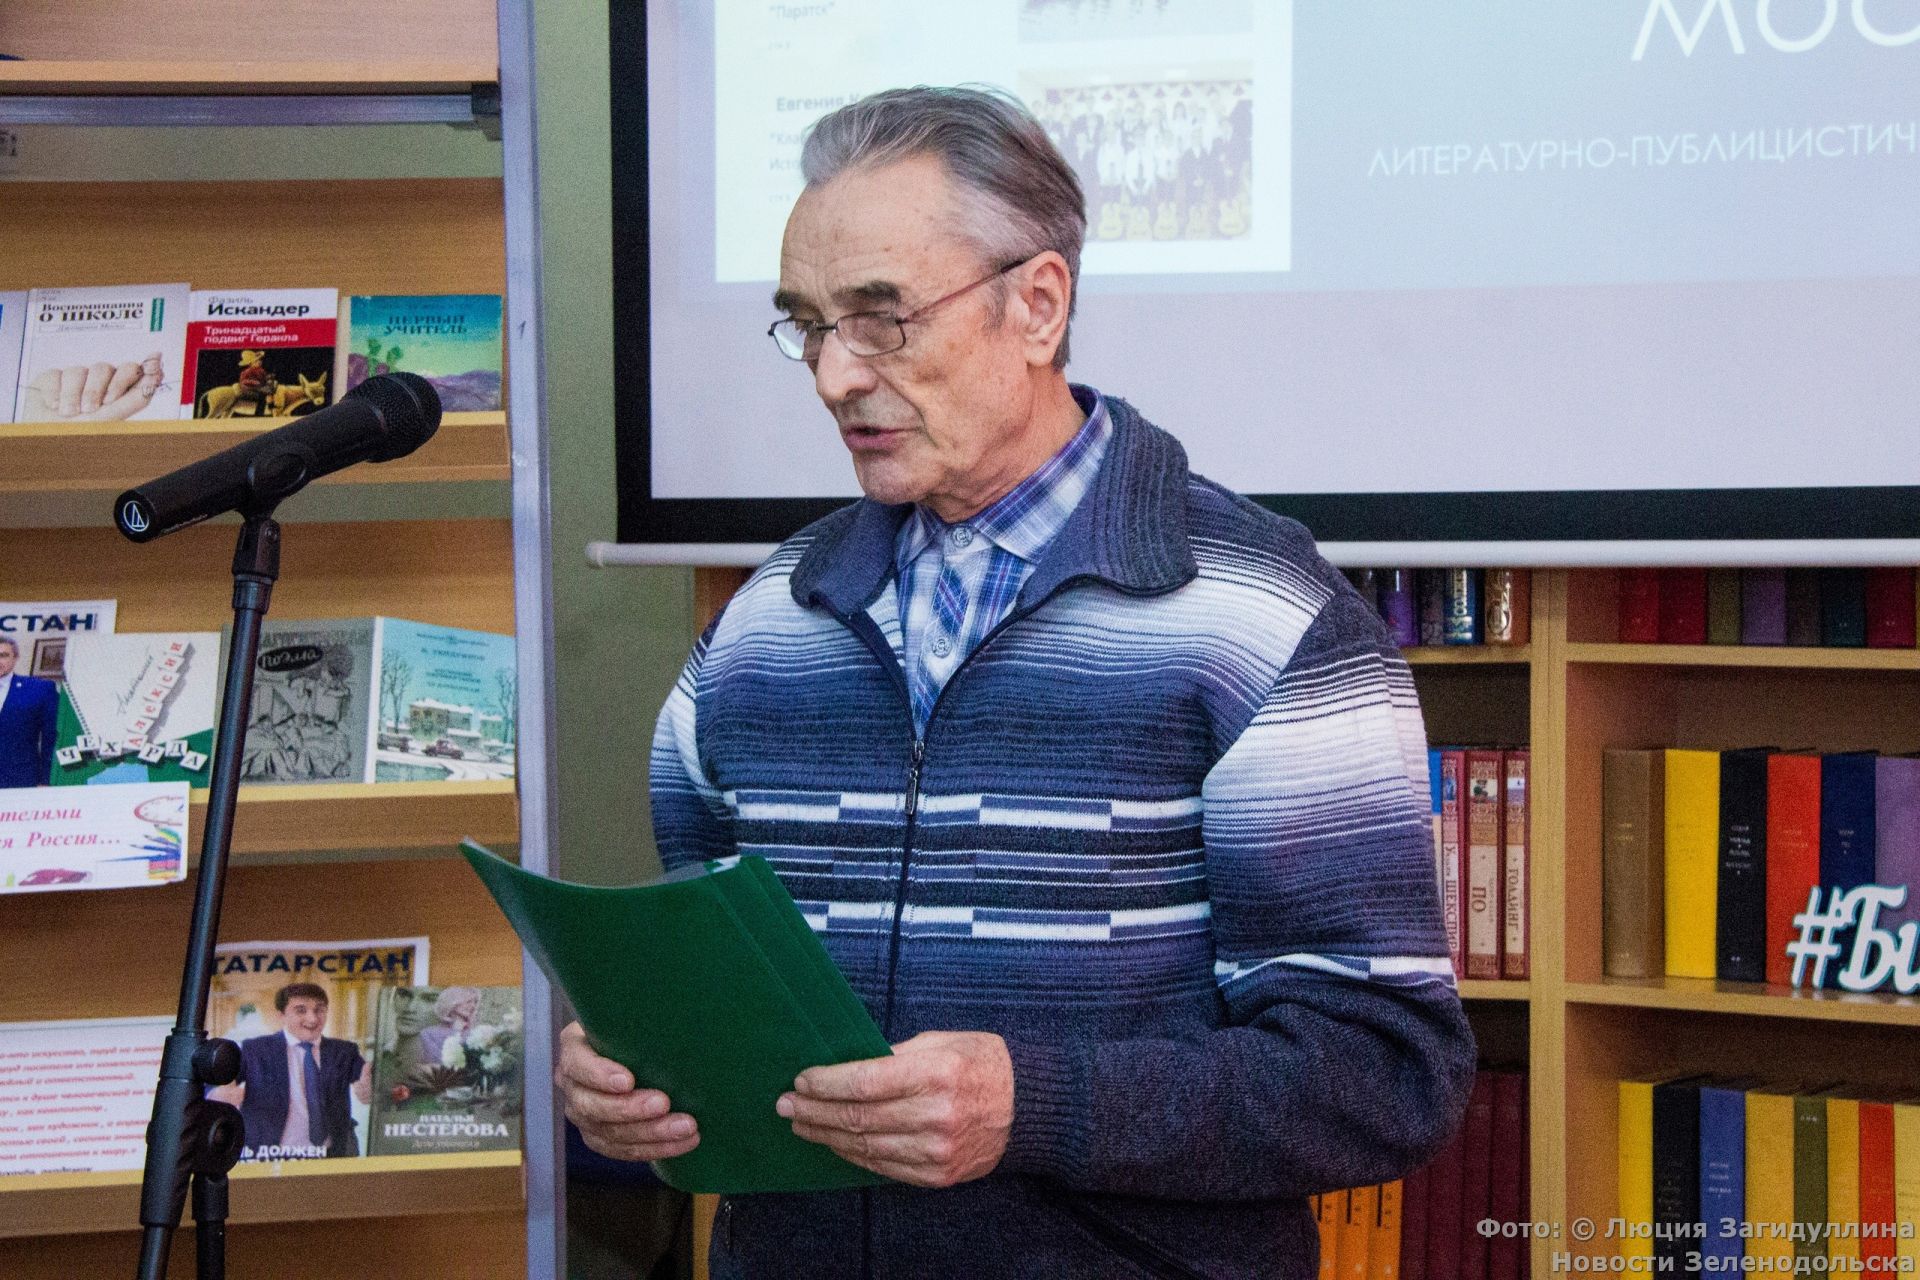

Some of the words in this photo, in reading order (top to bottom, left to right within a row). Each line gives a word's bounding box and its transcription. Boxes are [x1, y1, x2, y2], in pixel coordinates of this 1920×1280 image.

[208, 303, 310, 317] Искандер
[205, 324, 286, 335] Тринадцатый
[204, 335, 247, 344] подвиг
[250, 333, 299, 343] Геракла
[1472, 886, 1486, 913] ПО
[1508, 867, 1518, 931] ГОЛДИНГ
[384, 1123, 509, 1137] НЕСТЕРОВА
[256, 1145, 328, 1159] ДОЛЖЕН
